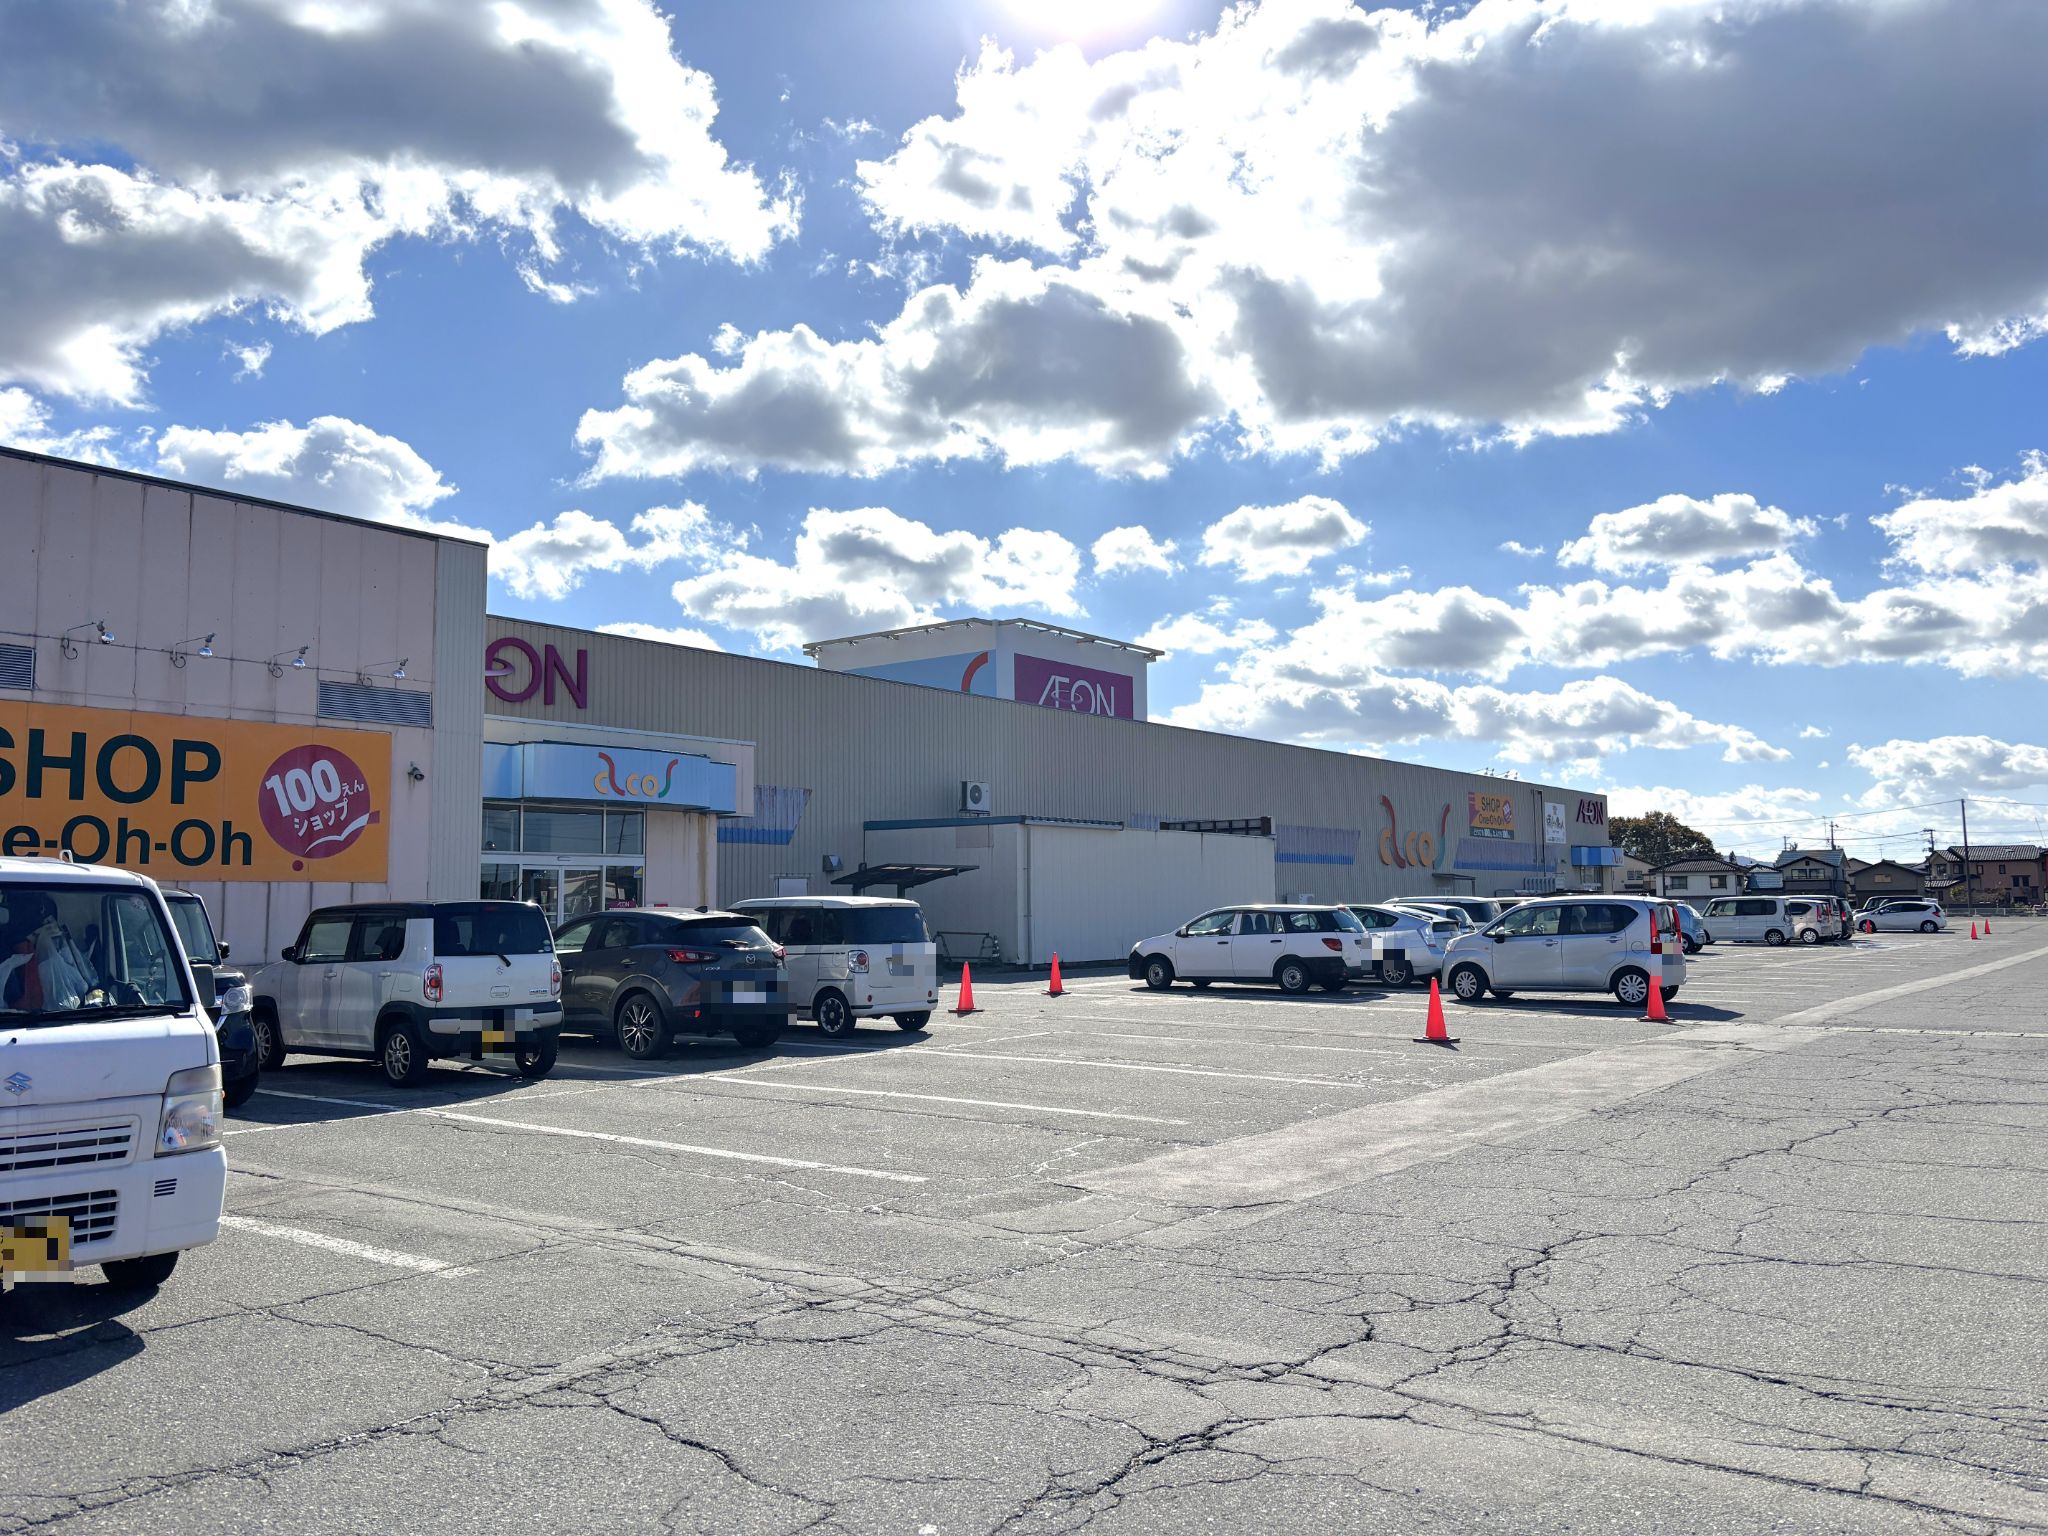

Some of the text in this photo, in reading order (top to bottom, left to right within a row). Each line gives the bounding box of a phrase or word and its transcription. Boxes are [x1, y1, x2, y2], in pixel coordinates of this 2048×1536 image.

[0, 726, 221, 804] HOP
[293, 797, 349, 837] ショップ
[1481, 796, 1501, 813] SHOP
